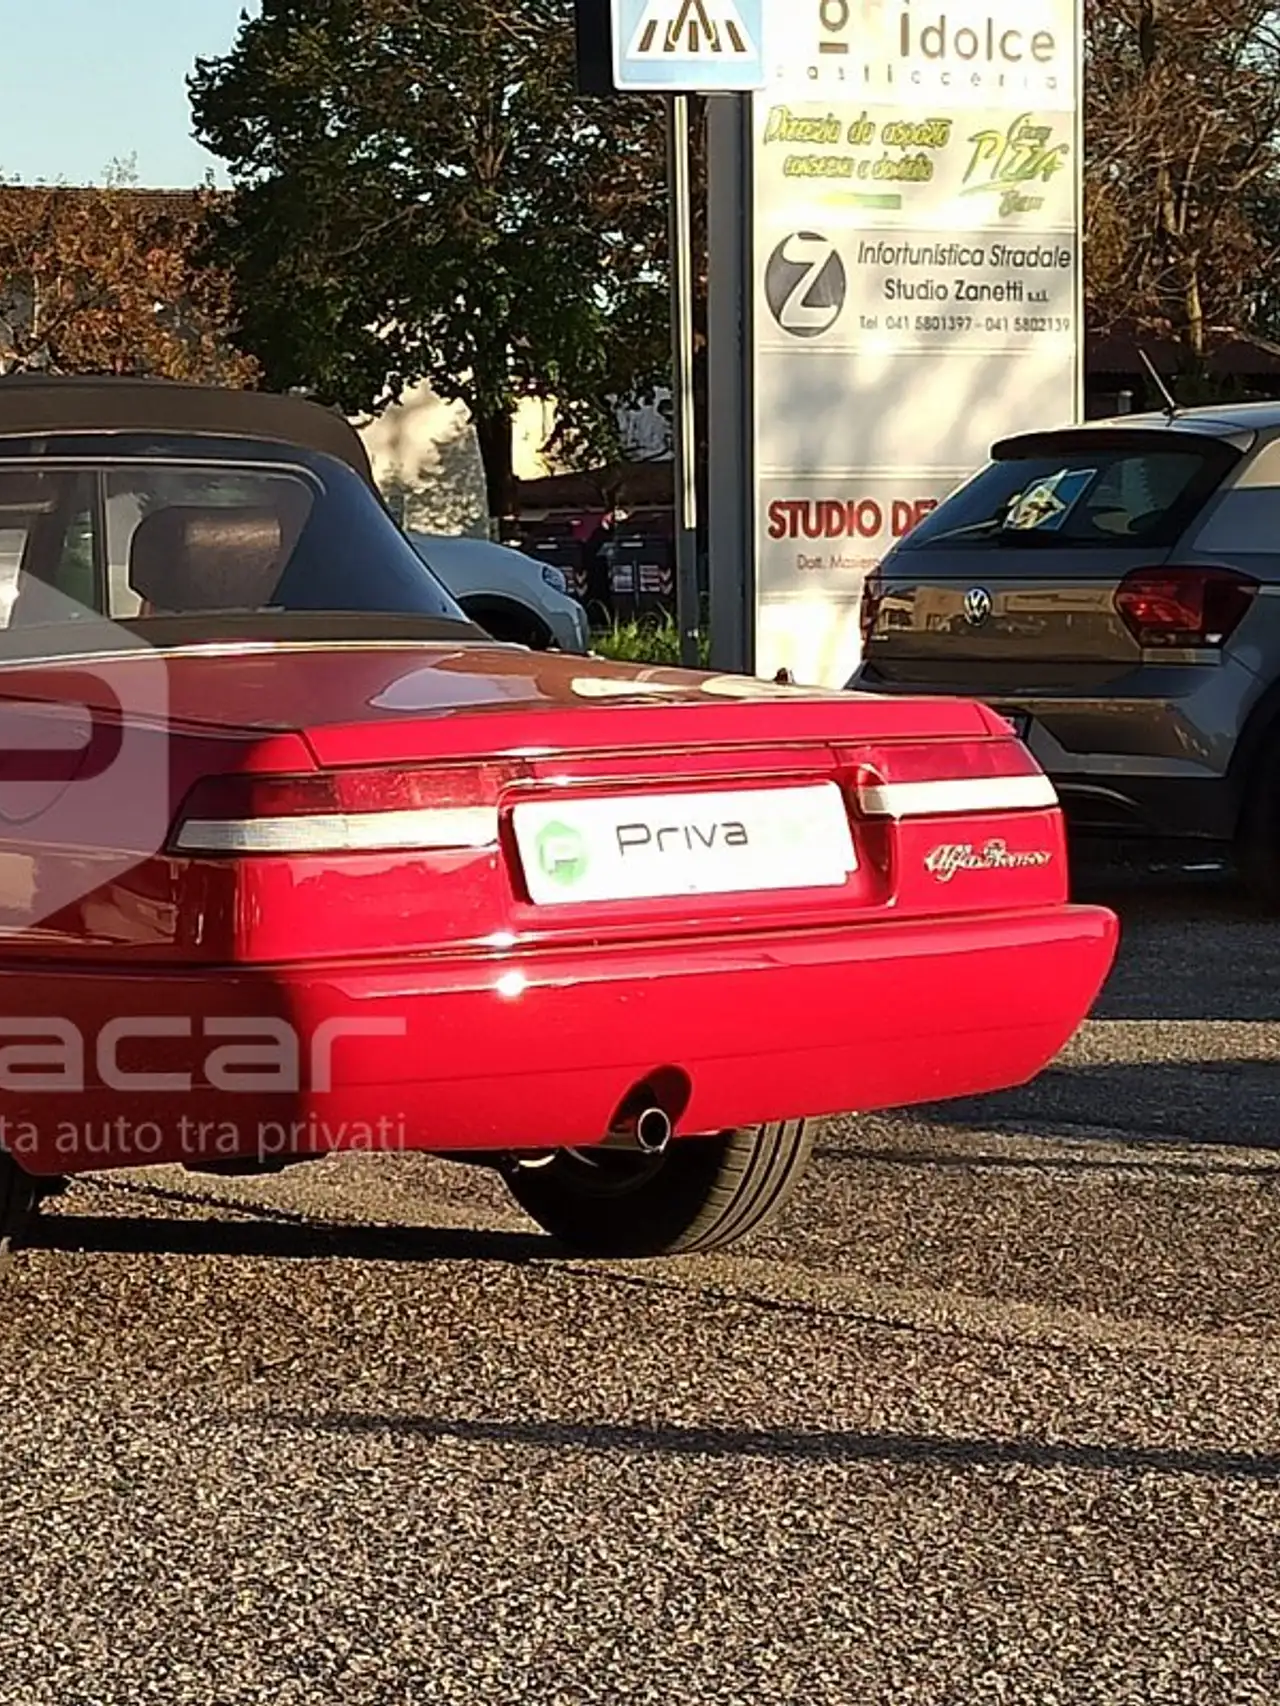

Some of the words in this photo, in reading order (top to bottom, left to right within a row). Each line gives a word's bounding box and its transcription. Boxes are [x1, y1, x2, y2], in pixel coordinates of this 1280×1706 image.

[857, 241, 985, 268] Infortunistica
[989, 244, 1071, 268] Stradale
[884, 278, 948, 301] Studio
[955, 279, 1024, 302] Zanetti
[885, 315, 911, 330] 041
[985, 317, 1010, 332] 041
[768, 500, 882, 539] STUDIO
